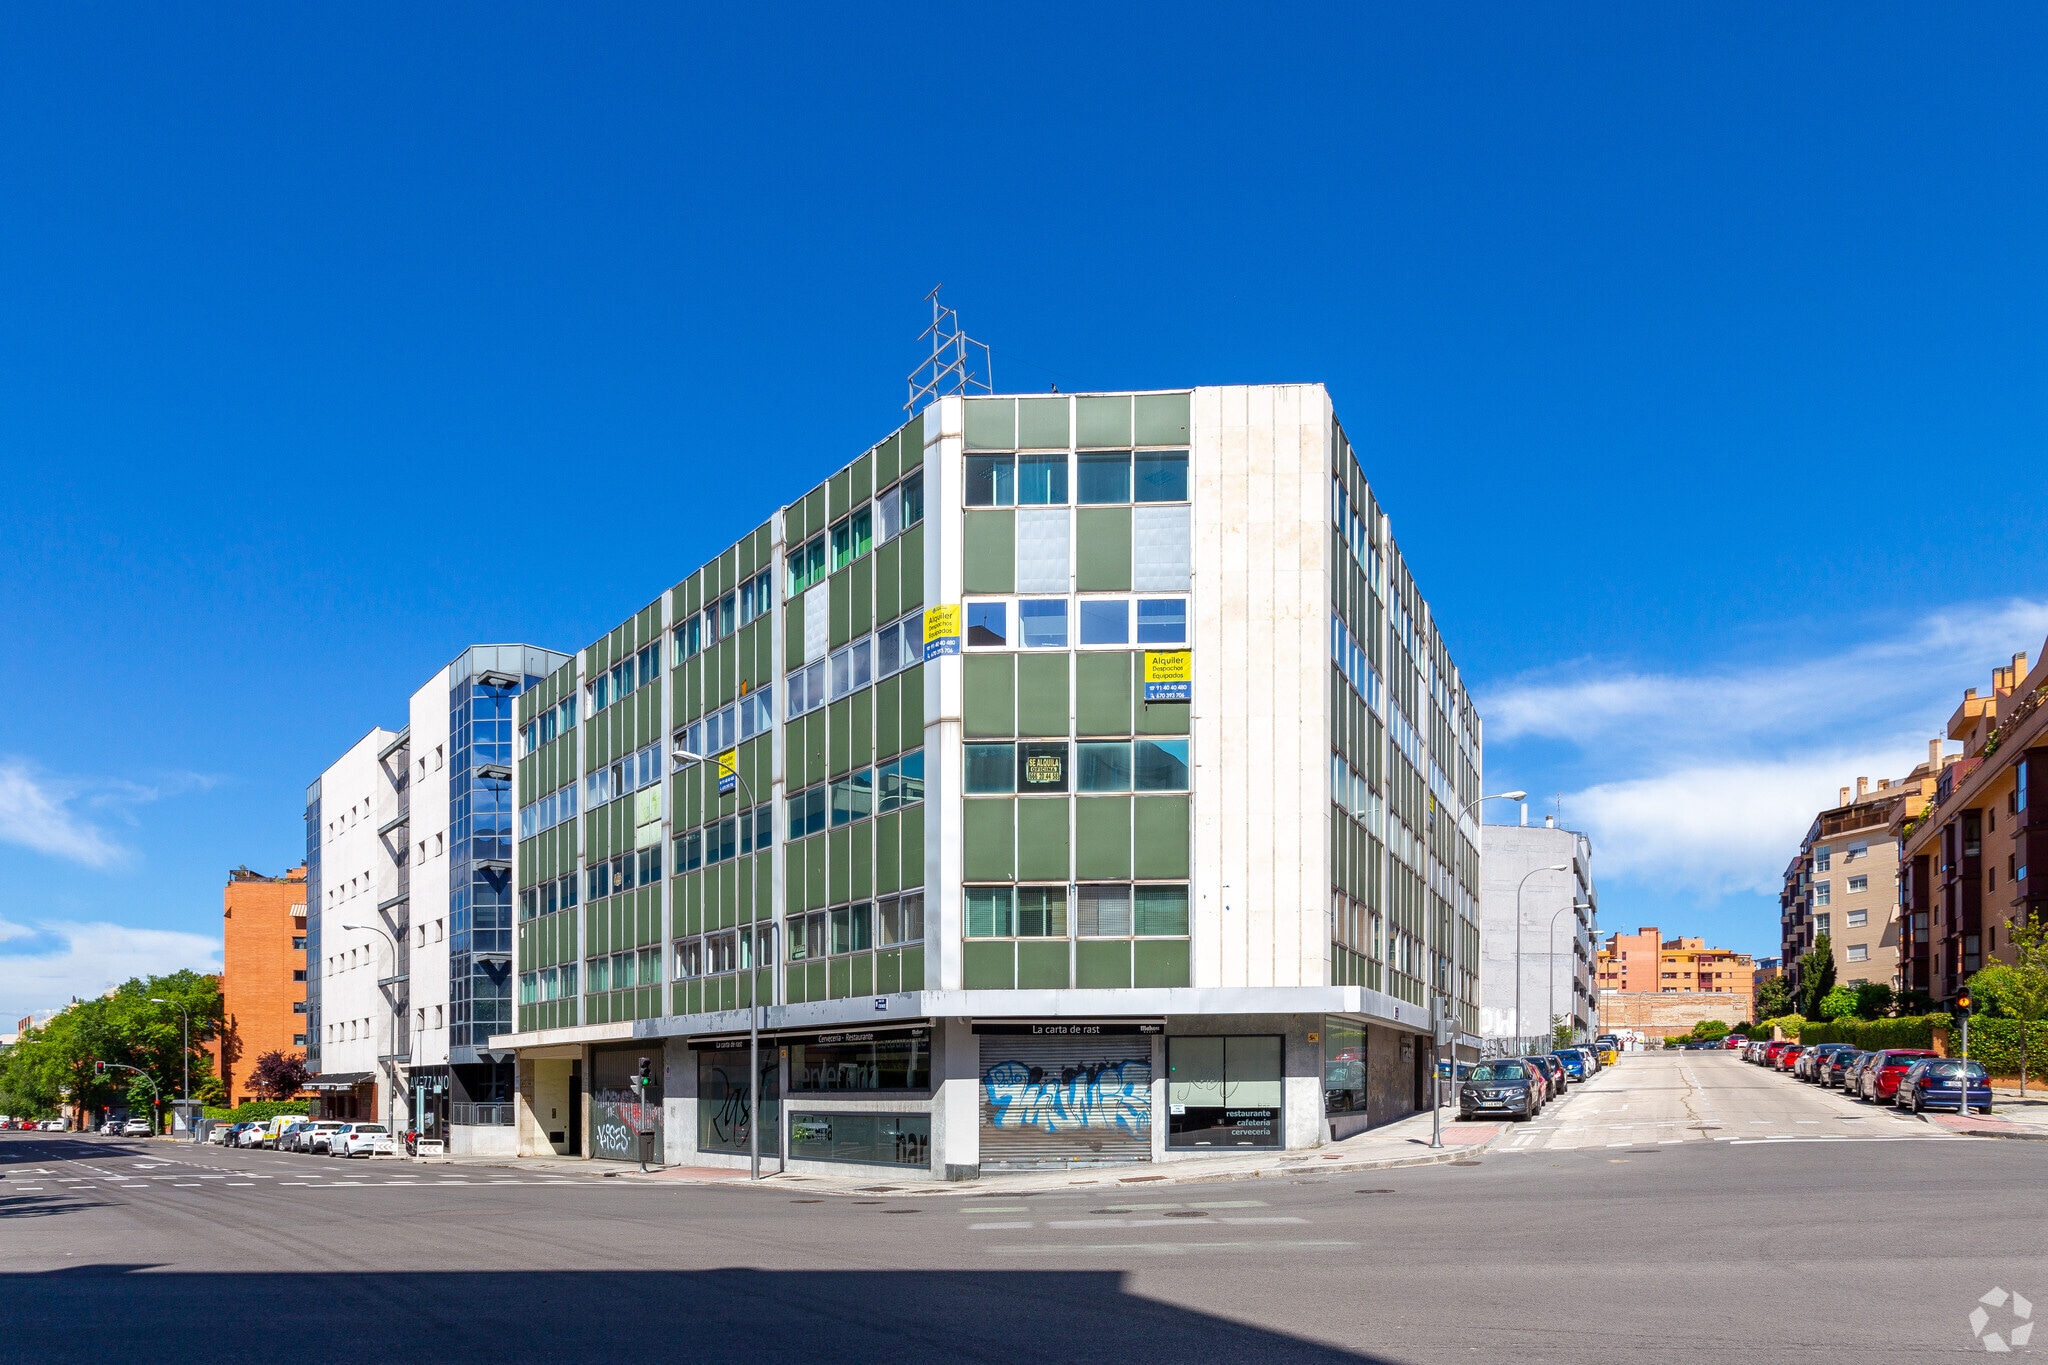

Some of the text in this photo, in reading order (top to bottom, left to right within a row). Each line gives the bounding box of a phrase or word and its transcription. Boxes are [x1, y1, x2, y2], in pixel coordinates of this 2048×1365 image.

[928, 612, 952, 624] Alquiler
[928, 620, 952, 632] Despachos
[928, 628, 952, 638] Equipados
[1152, 656, 1184, 666] Alquiler
[1029, 758, 1059, 767] SE ALQUILA
[1032, 1025, 1100, 1034] La carta de rast
[846, 1033, 874, 1041] Restaurante
[410, 1075, 449, 1090] AVEZZANO
